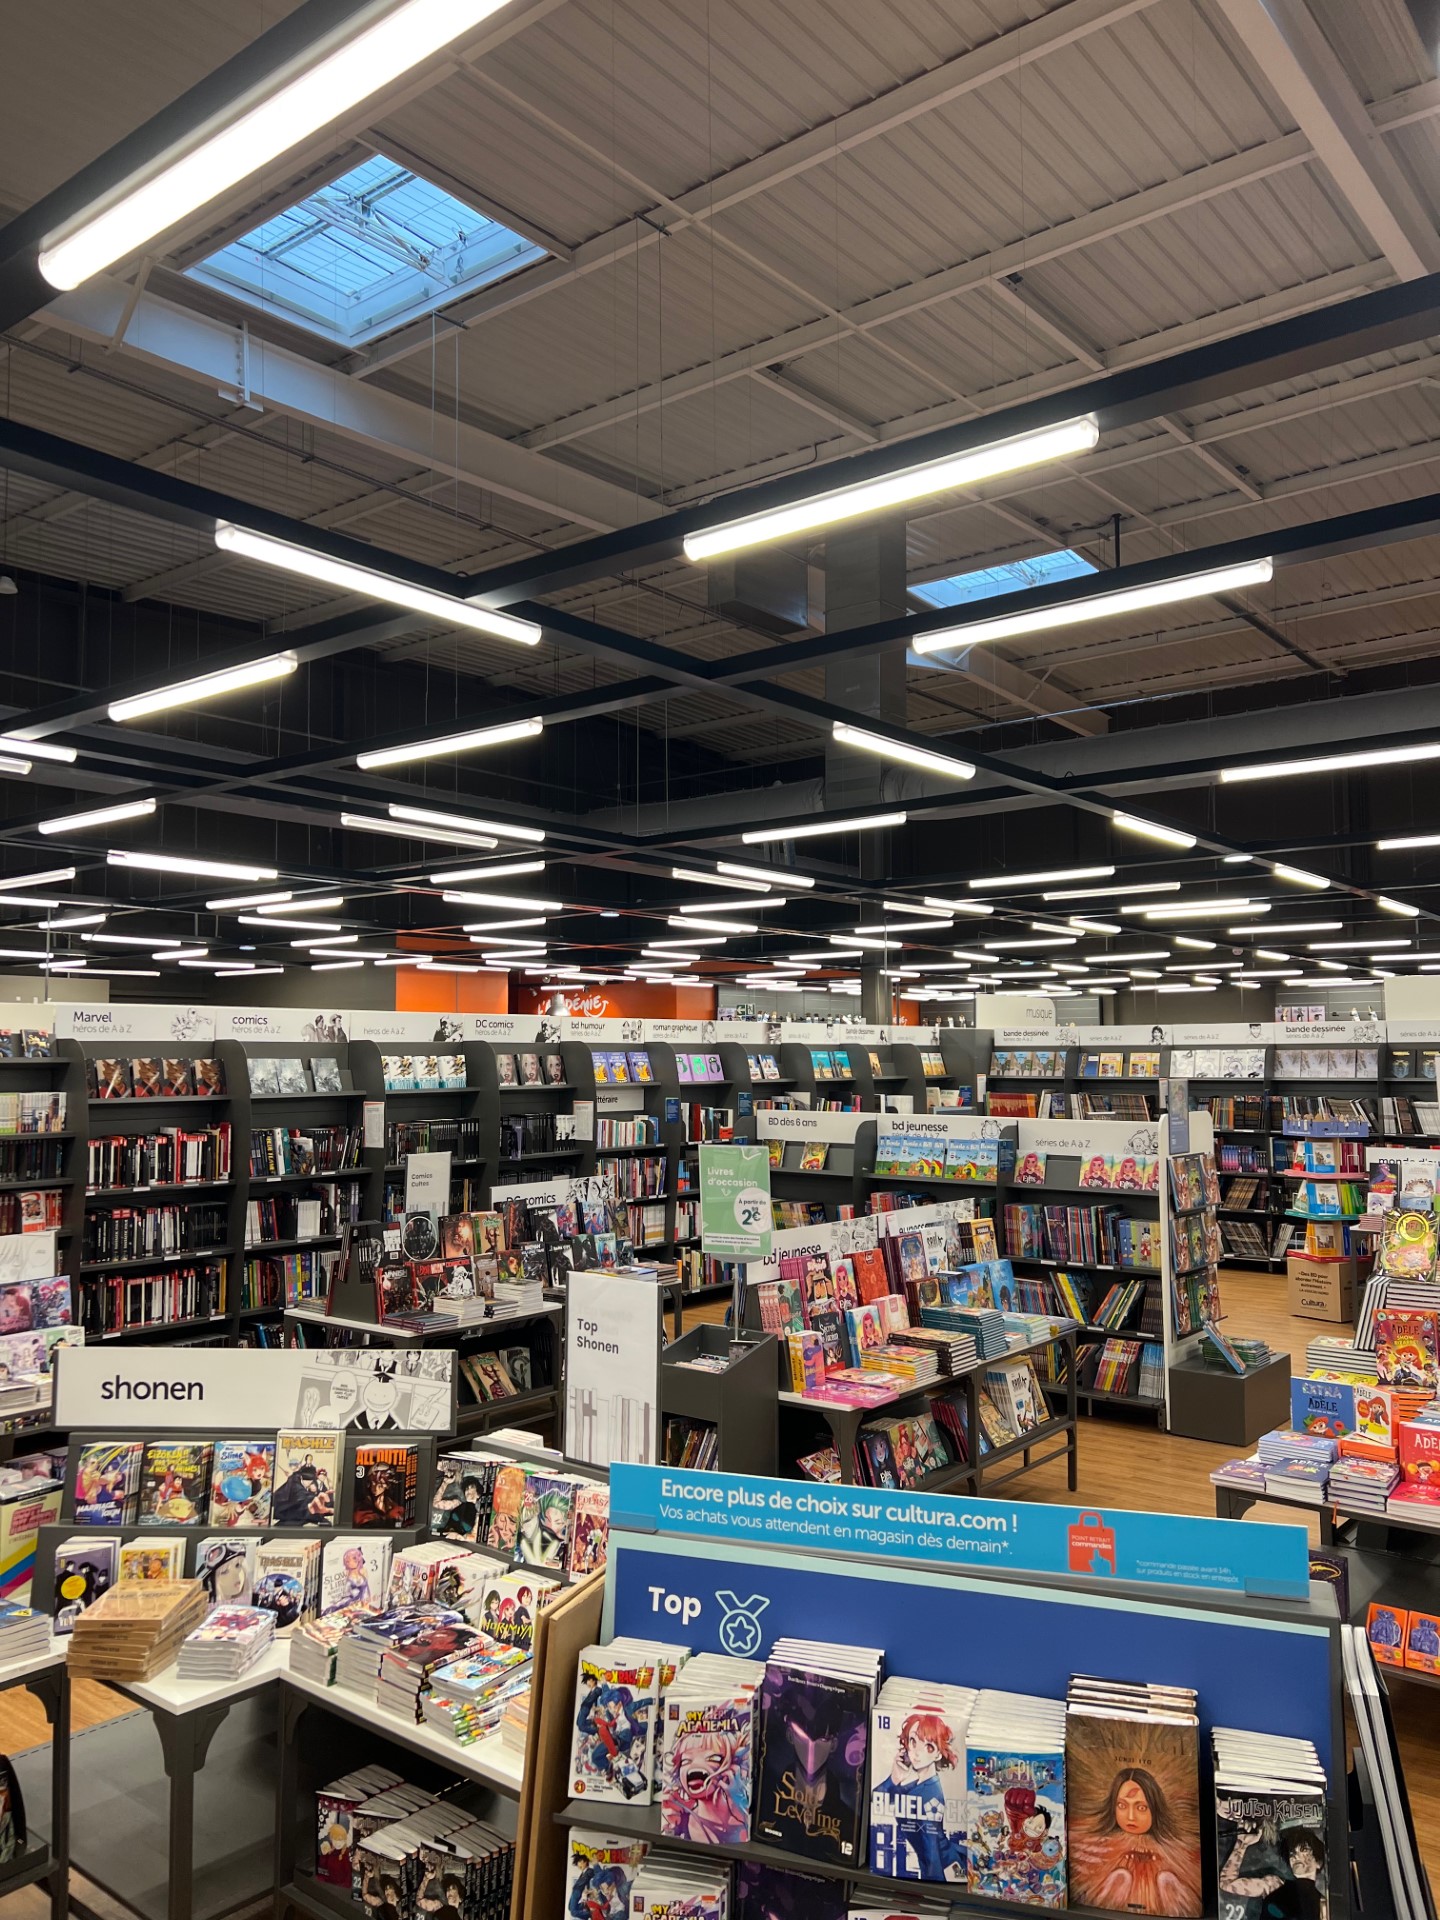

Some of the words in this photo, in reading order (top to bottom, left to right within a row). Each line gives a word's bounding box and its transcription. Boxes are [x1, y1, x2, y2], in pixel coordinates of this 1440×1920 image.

[73, 1011, 112, 1024] Marvel
[232, 1015, 268, 1026] comics
[1026, 1007, 1053, 1021] musique
[72, 1025, 97, 1035] héros
[99, 1025, 110, 1035] de
[111, 1025, 118, 1034] A
[125, 1025, 132, 1034] Z
[231, 1026, 252, 1036] héros
[254, 1026, 263, 1036] de
[475, 1019, 487, 1030] DC
[488, 1019, 514, 1030] comics
[571, 1021, 580, 1030] bd
[581, 1021, 606, 1030] humour
[652, 1023, 671, 1032] roman
[672, 1023, 698, 1033] graphique
[1286, 1025, 1310, 1034] bande
[1311, 1024, 1346, 1033] dessinée
[1003, 1029, 1022, 1037] bande
[1023, 1029, 1049, 1037] dessinée
[768, 1117, 779, 1127] BD
[780, 1116, 795, 1127] dès
[796, 1117, 802, 1127] 6
[803, 1118, 818, 1128] ans
[892, 1120, 905, 1131] bd
[906, 1121, 949, 1133] jeunesse
[1035, 1139, 1057, 1148] séries
[1058, 1139, 1070, 1148] de
[1071, 1139, 1077, 1148] A
[1085, 1139, 1091, 1148] Z
[411, 1173, 433, 1181] Comics
[707, 1167, 734, 1176] Livres
[411, 1180, 430, 1188] Cultes
[707, 1177, 758, 1188] d'occasion
[527, 1193, 556, 1206] comics
[778, 1243, 822, 1267] jeunesse
[1301, 1298, 1325, 1308] Cultura
[577, 1317, 599, 1333] Top
[576, 1335, 620, 1355] Shonen
[100, 1373, 205, 1402] shonen
[1302, 1382, 1343, 1400] EXTRA
[355, 1448, 376, 1464] ALL
[376, 1448, 407, 1465] OUT!!
[355, 1465, 365, 1480] 3
[661, 1478, 725, 1503] Encore
[727, 1486, 765, 1511] plus
[768, 1489, 793, 1511] de
[796, 1492, 849, 1517] choix
[852, 1502, 883, 1521] sur
[886, 1504, 1007, 1533] cultura.com
[1011, 1514, 1019, 1533] !
[432, 1513, 442, 1524] 22
[660, 1503, 684, 1521] Vos
[686, 1506, 728, 1525] achats
[731, 1513, 763, 1529] vous
[765, 1515, 831, 1538] attendent
[833, 1523, 853, 1538] en
[855, 1525, 915, 1548] magasin
[917, 1529, 944, 1549] dès
[1072, 1534, 1089, 1542] POINT
[1071, 1541, 1112, 1550] commandes
[370, 1559, 379, 1572] 3
[1200, 1565, 1218, 1573] avant
[324, 1571, 348, 1585] SLOW
[1147, 1569, 1173, 1578] produits
[1183, 1571, 1201, 1580] stock
[648, 1586, 702, 1625] Top
[581, 1659, 619, 1685] DRAGON
[618, 1668, 638, 1686] BALL
[685, 1710, 705, 1722] MY
[877, 1715, 891, 1730] 18
[676, 1719, 742, 1738] ACADEMIA
[774, 1792, 842, 1836] Leveling
[1223, 1796, 1273, 1819] JUJUTSU
[1273, 1798, 1320, 1823] KAISEN
[840, 1841, 854, 1856] 12
[353, 1876, 363, 1888] 22
[650, 1903, 670, 1916] MY
[1225, 1903, 1246, 1920] 22
